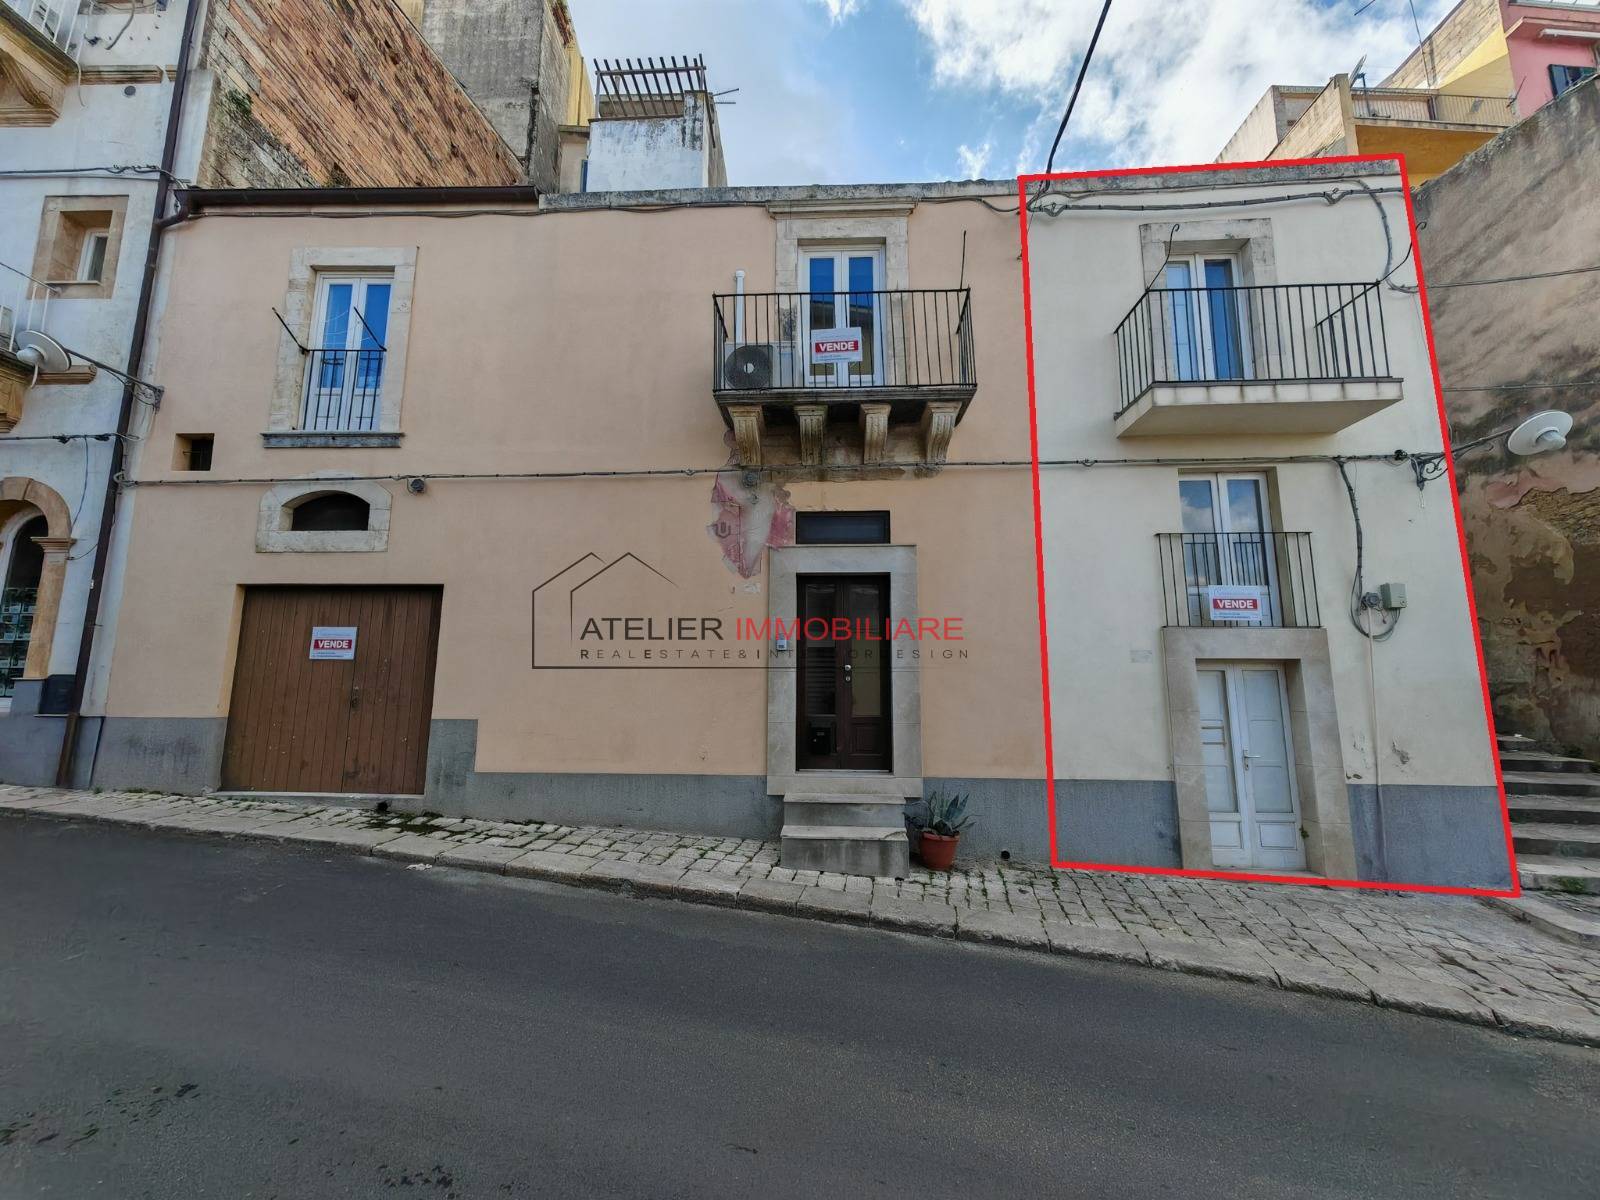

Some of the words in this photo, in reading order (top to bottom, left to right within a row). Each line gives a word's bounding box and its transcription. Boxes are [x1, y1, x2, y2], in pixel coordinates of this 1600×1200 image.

[818, 341, 855, 352] VENDE
[1216, 599, 1254, 609] VENDE
[318, 640, 350, 649] VENDE
